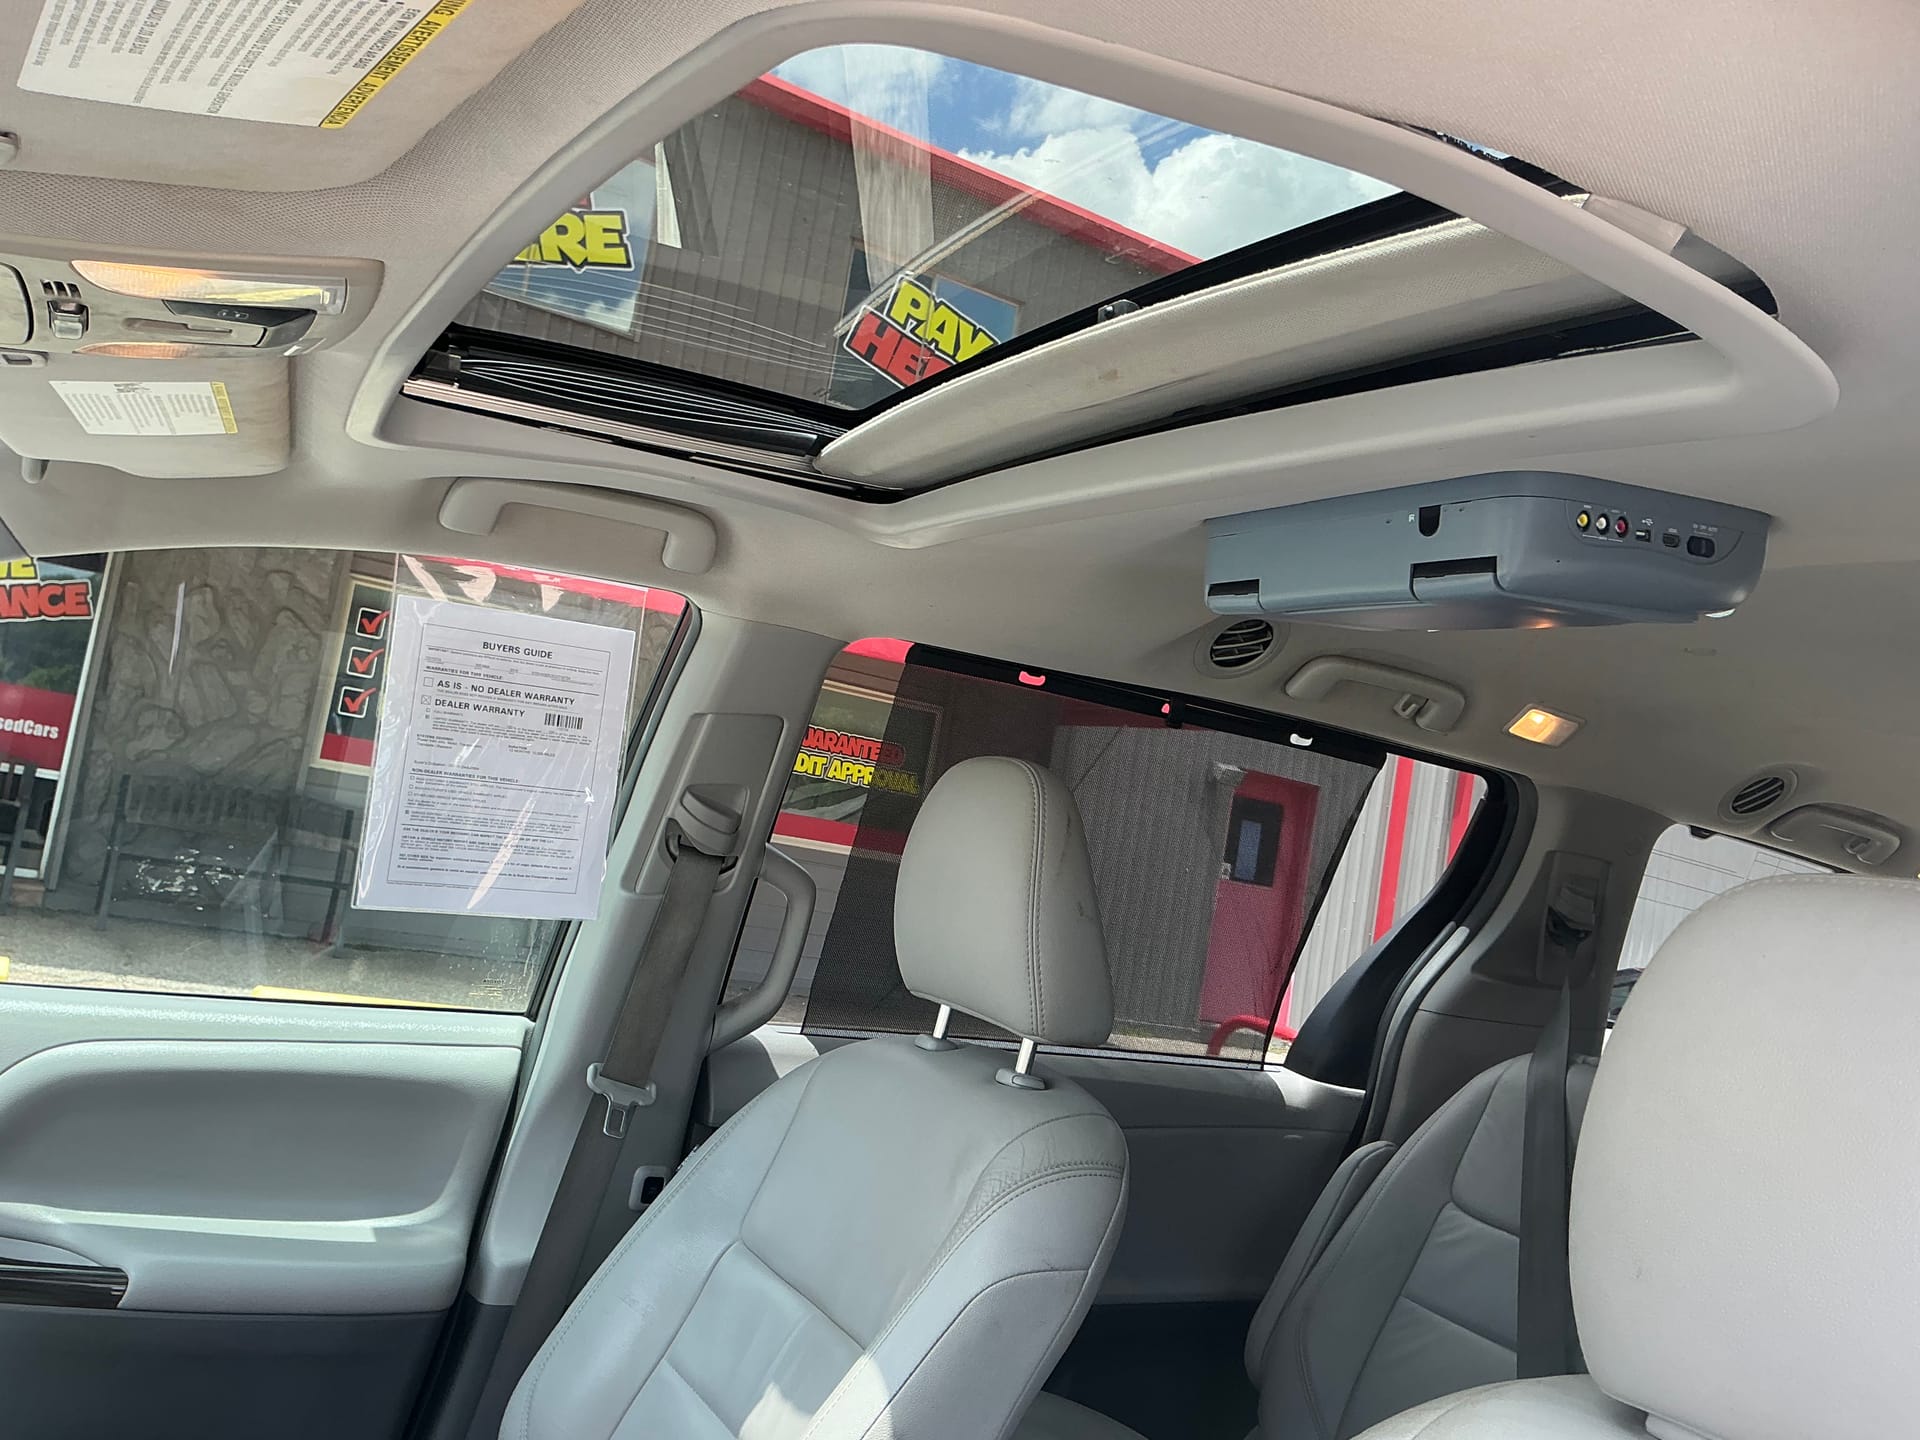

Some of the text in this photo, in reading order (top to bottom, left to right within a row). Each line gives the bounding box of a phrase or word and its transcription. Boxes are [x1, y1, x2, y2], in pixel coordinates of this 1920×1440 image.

[370, 20, 443, 81] AVERTISSEMENT
[324, 82, 379, 125] ADVERTENCIA
[888, 278, 996, 364] PAY
[482, 641, 553, 660] BUYERS GUIDE
[434, 698, 470, 710] DEALER
[473, 703, 525, 717] WARRANTY
[437, 680, 451, 689] AS
[453, 682, 463, 690] IS
[471, 684, 485, 694] NO
[487, 687, 522, 698] DEALER
[524, 691, 576, 705] WARRANTY
